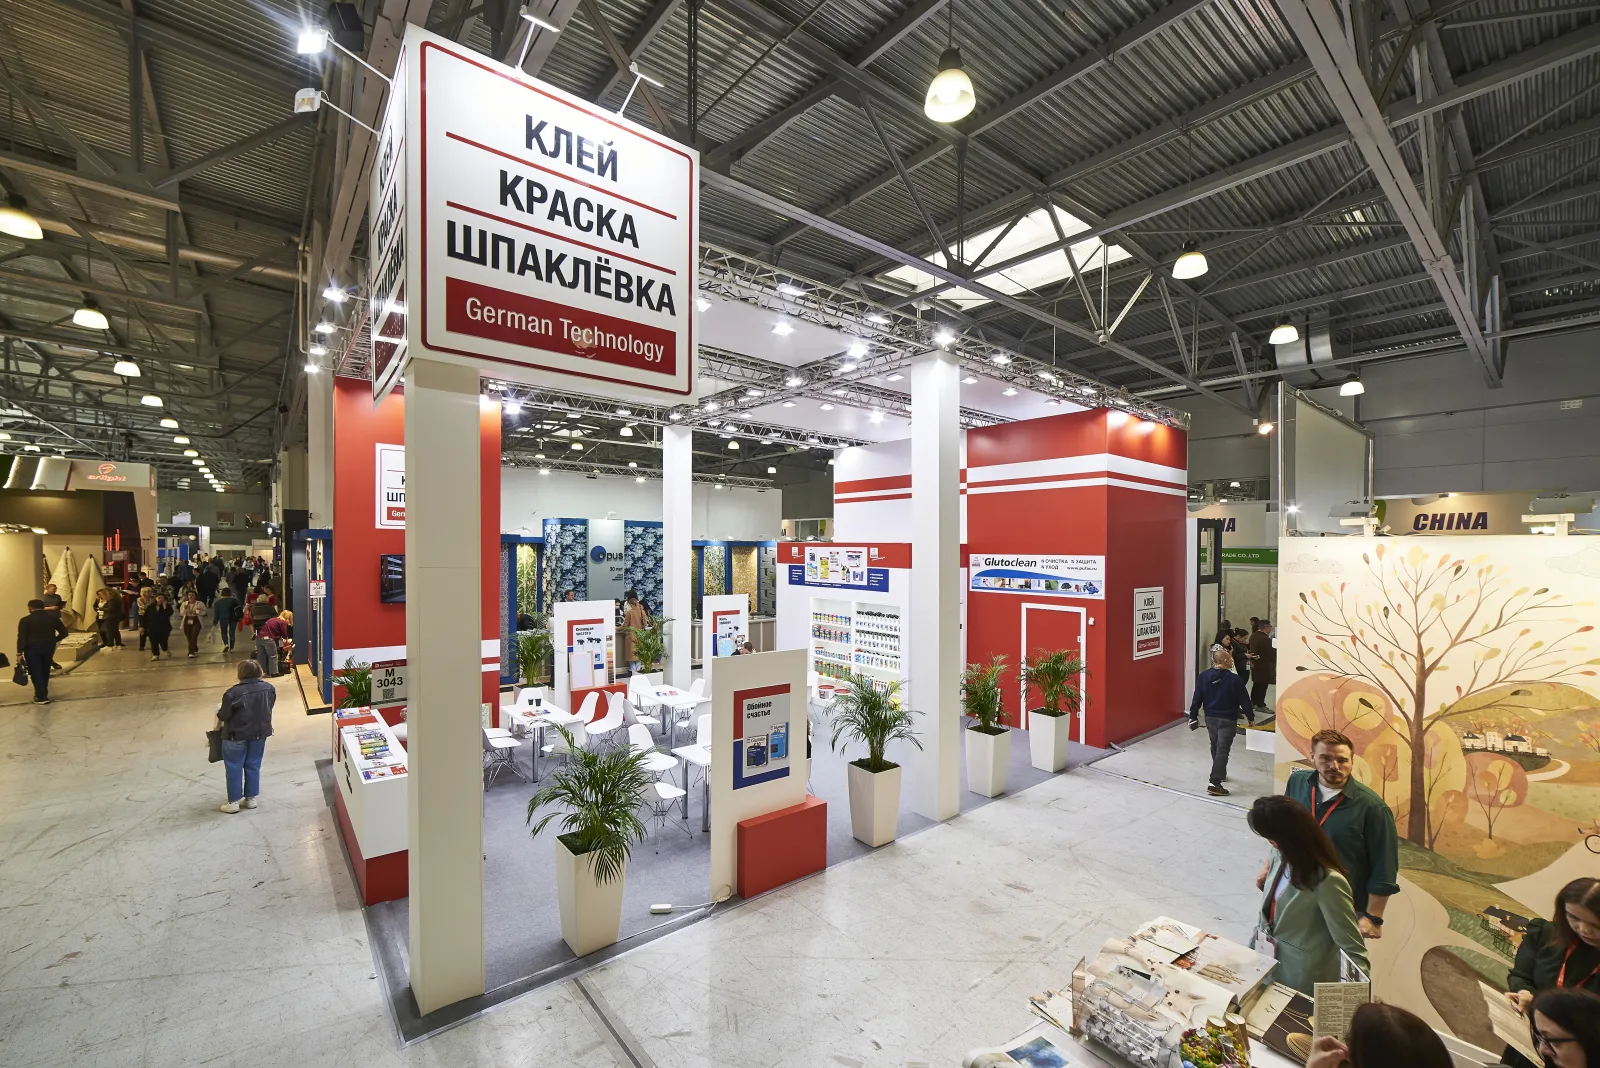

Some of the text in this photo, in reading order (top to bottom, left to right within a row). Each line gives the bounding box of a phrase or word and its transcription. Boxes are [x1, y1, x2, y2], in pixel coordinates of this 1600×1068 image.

[525, 114, 619, 182] КЛЕЙ
[499, 169, 640, 249] КРАСКА
[446, 219, 677, 317] ШПАКЛЁВКА
[466, 296, 665, 363] German Technology
[1413, 512, 1488, 531] CHINA
[984, 557, 1037, 568] Glutoclean
[1141, 611, 1157, 621] КРАСКА
[385, 668, 395, 677] M
[376, 676, 404, 688] 3043
[746, 701, 773, 711] Обойное
[746, 709, 771, 719] счастье
